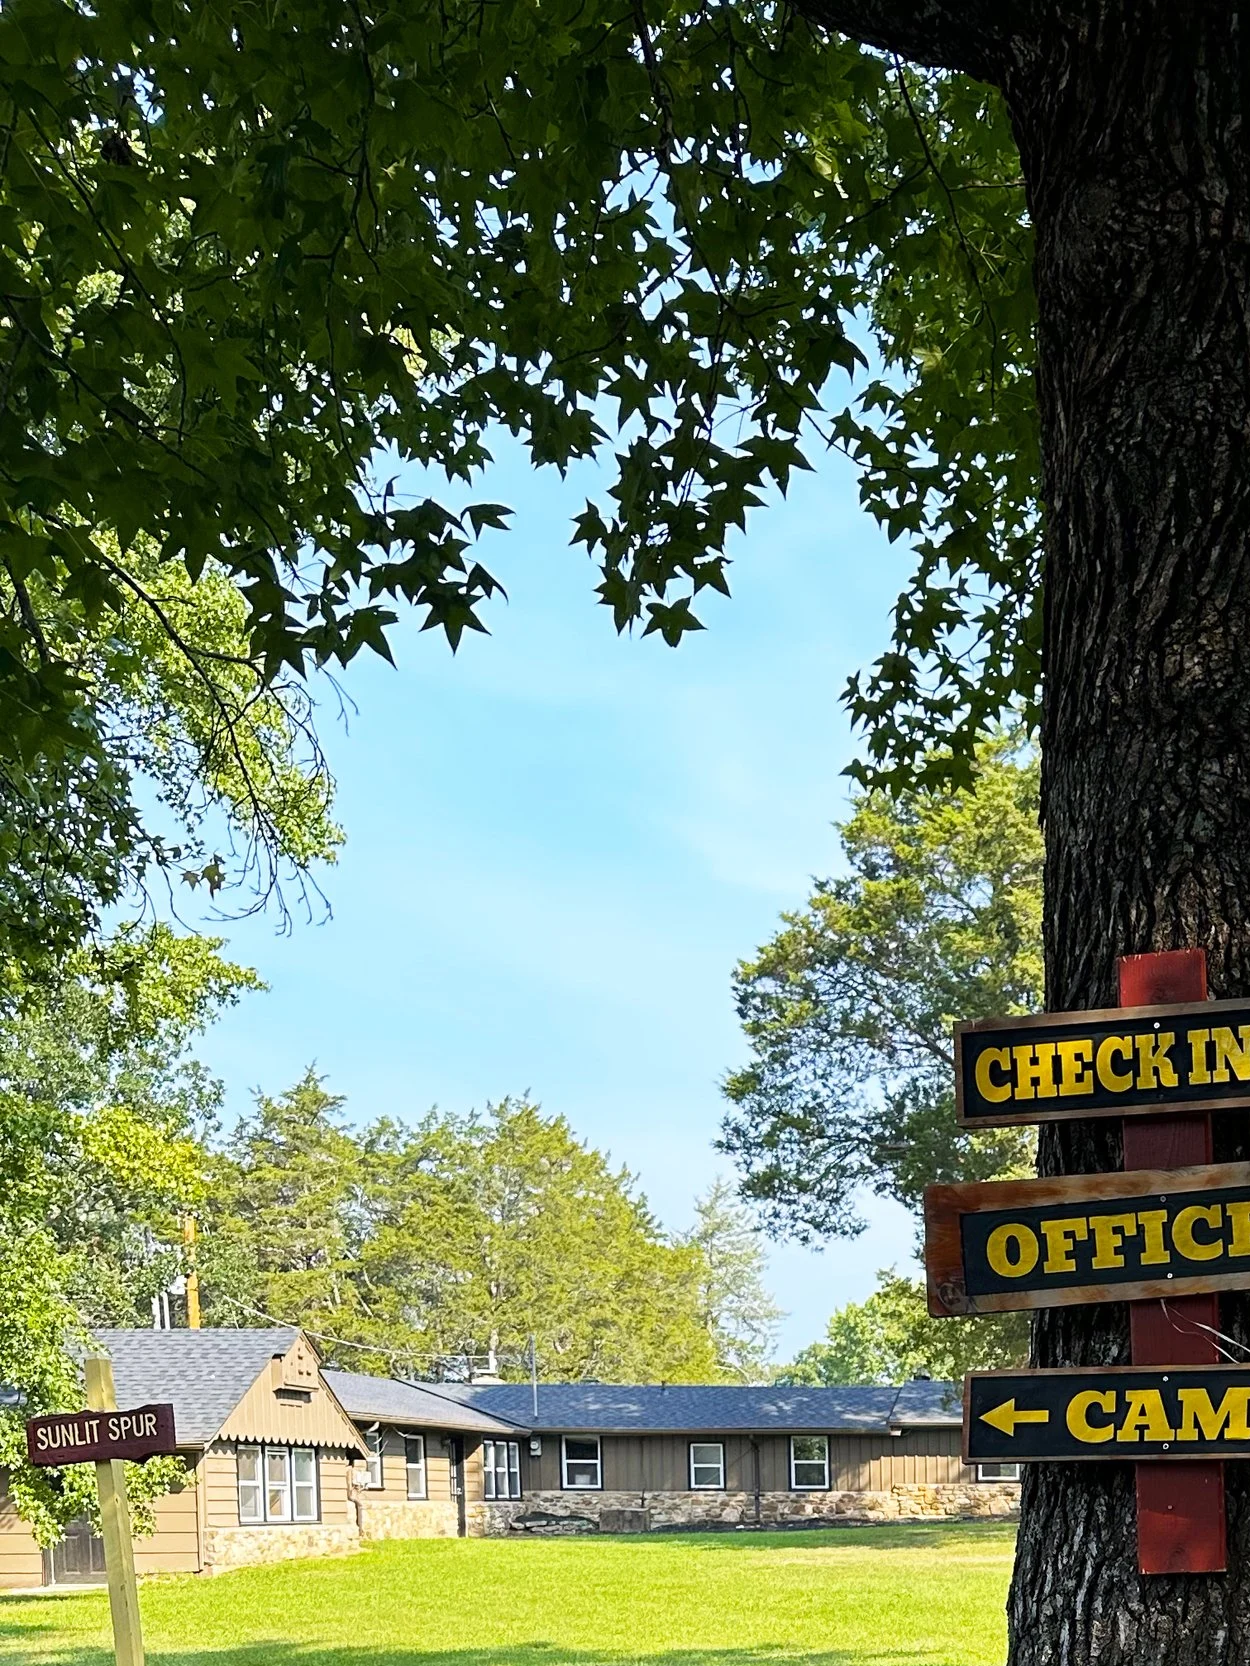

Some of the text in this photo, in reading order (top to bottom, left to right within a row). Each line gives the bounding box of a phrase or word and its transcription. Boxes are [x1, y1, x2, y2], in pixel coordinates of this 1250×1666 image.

[975, 1031, 1179, 1103] CHECK
[36, 1413, 157, 1450] SUNLIT SPUR
